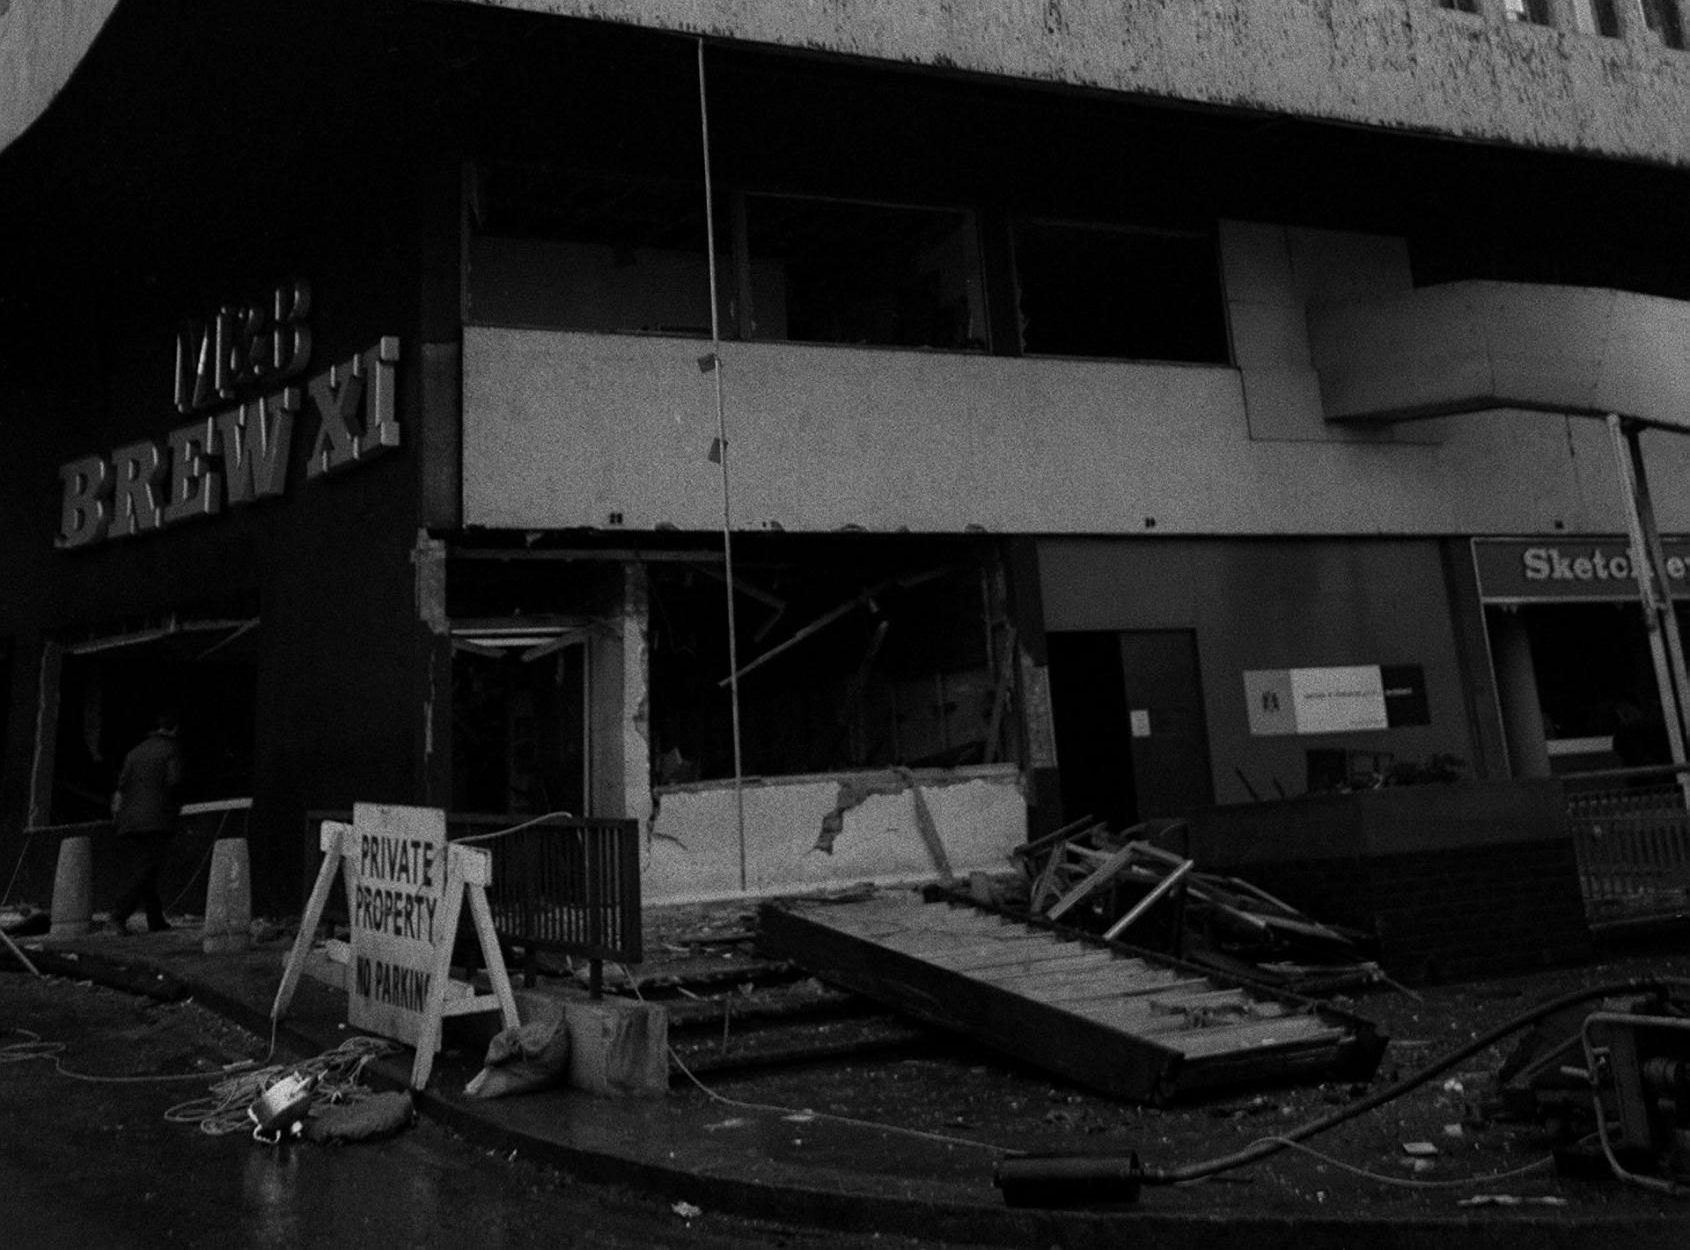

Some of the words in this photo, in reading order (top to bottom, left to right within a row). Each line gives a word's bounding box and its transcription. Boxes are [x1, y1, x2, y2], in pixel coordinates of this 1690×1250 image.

[54, 387, 302, 548] BREW
[305, 336, 401, 479] XI
[361, 834, 434, 888] PRIVATE
[354, 884, 438, 944] PROPERTY
[355, 954, 372, 998] NO
